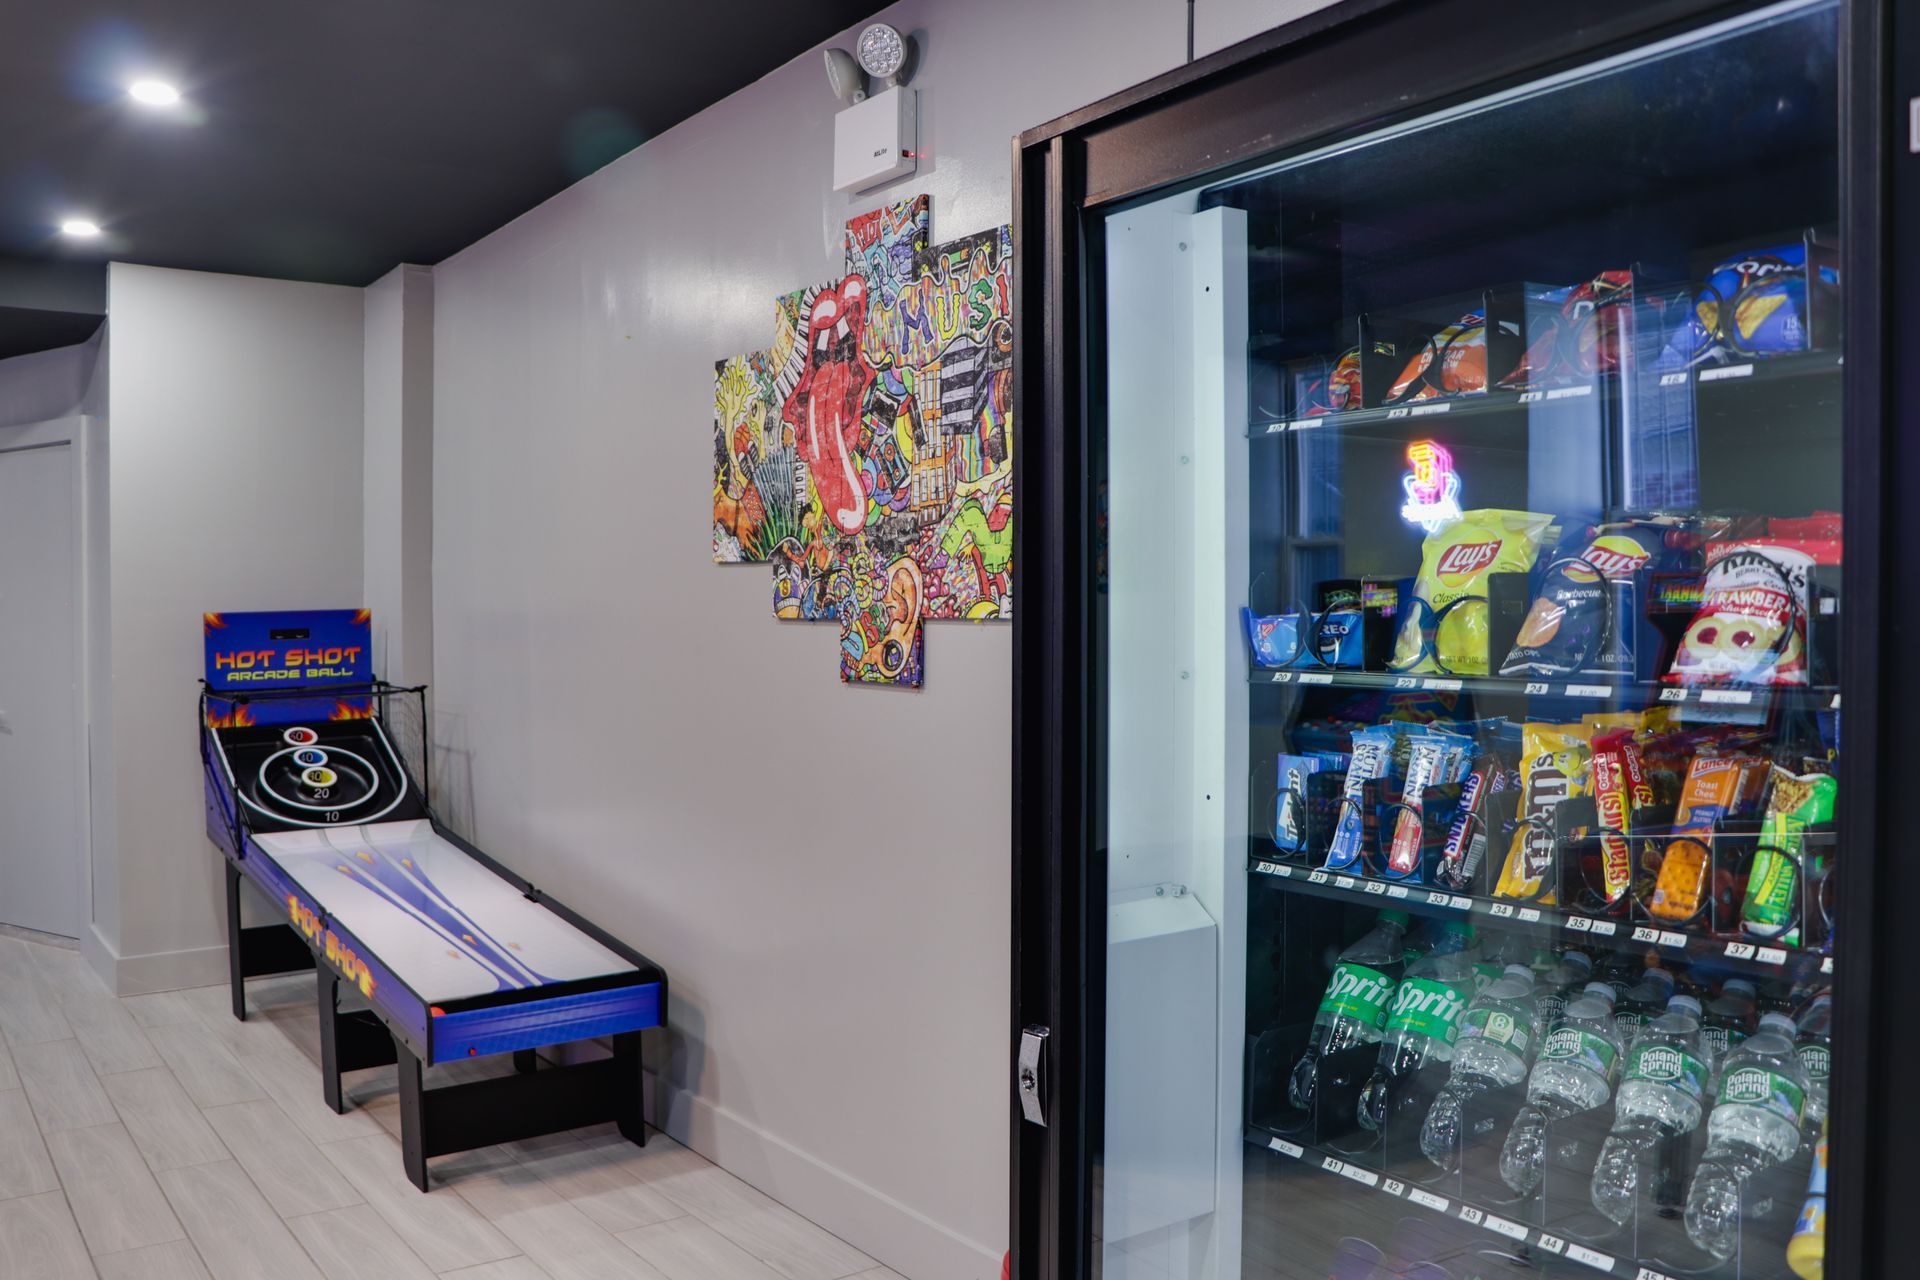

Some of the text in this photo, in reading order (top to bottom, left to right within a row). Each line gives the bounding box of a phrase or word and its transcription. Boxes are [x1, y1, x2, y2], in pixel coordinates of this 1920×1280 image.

[1439, 541, 1499, 575] Lay's
[1319, 624, 1350, 636] REO
[215, 646, 361, 669] HOT SHOT
[226, 666, 354, 682] ARCADE BALL
[1276, 673, 1289, 682] 20
[1400, 679, 1412, 688] 22
[1530, 684, 1543, 693] 24
[1666, 690, 1681, 699] 26
[1694, 757, 1734, 772] Lance
[313, 787, 330, 799] 20
[324, 810, 340, 822] 10
[1444, 773, 1480, 852] SNICKERS
[1260, 863, 1273, 872] 30
[1312, 873, 1323, 881] 31
[1368, 883, 1382, 892] 32
[1430, 894, 1444, 904] 33
[1494, 905, 1508, 915] 34
[1570, 918, 1586, 929] 35
[1594, 925, 1613, 934] $1.50
[1637, 929, 1653, 941] 36
[1663, 936, 1683, 945] $1.50
[1730, 944, 1748, 955] 37
[1760, 952, 1782, 961] $1.50
[1546, 1031, 1583, 1044] Poland
[1543, 1041, 1582, 1057] Spring
[1640, 1050, 1683, 1065] Poland
[1639, 1061, 1683, 1077] Spring
[1726, 1071, 1770, 1087] Poland
[1725, 1082, 1770, 1100] Spring
[1326, 1158, 1339, 1171] 41
[1387, 1180, 1400, 1193] 42
[1463, 1208, 1478, 1221] 43
[1543, 1237, 1558, 1250] 44
